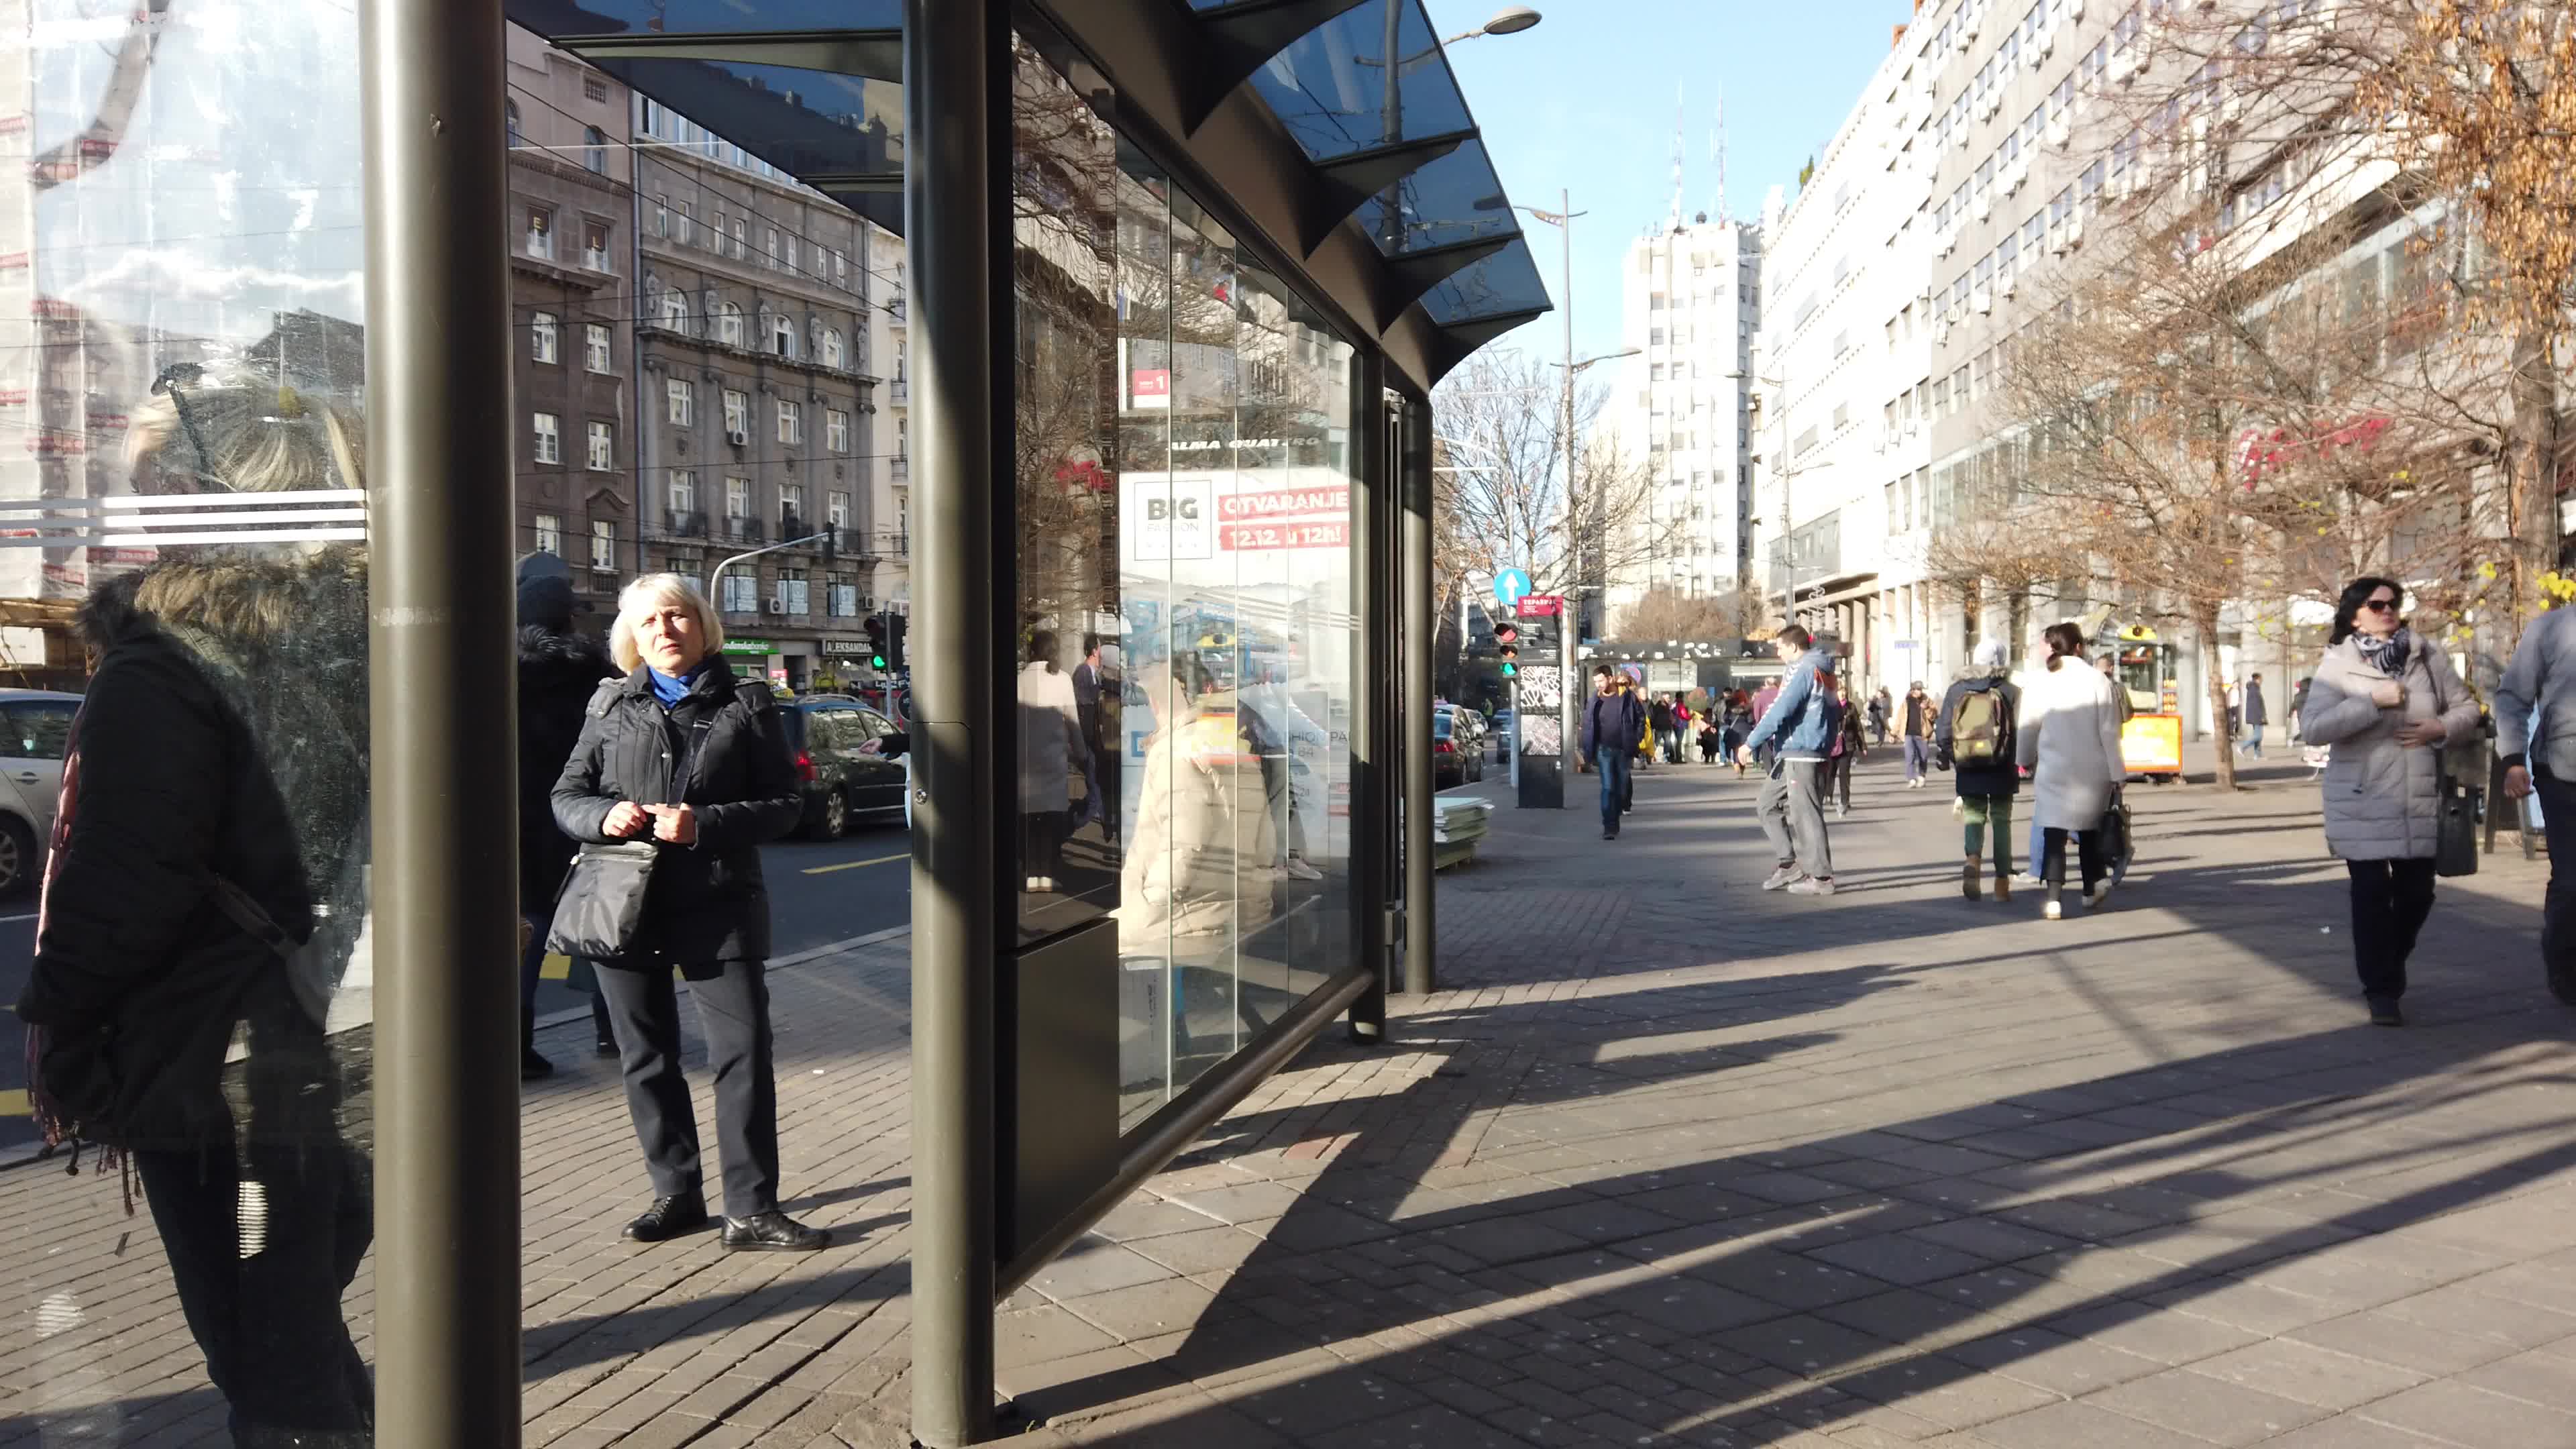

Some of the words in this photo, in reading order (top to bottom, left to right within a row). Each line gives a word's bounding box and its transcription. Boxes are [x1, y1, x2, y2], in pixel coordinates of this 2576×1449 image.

[1228, 437, 1320, 449] QUATRO
[1148, 497, 1198, 521] BIG
[1224, 491, 1348, 515] OTVARANJE
